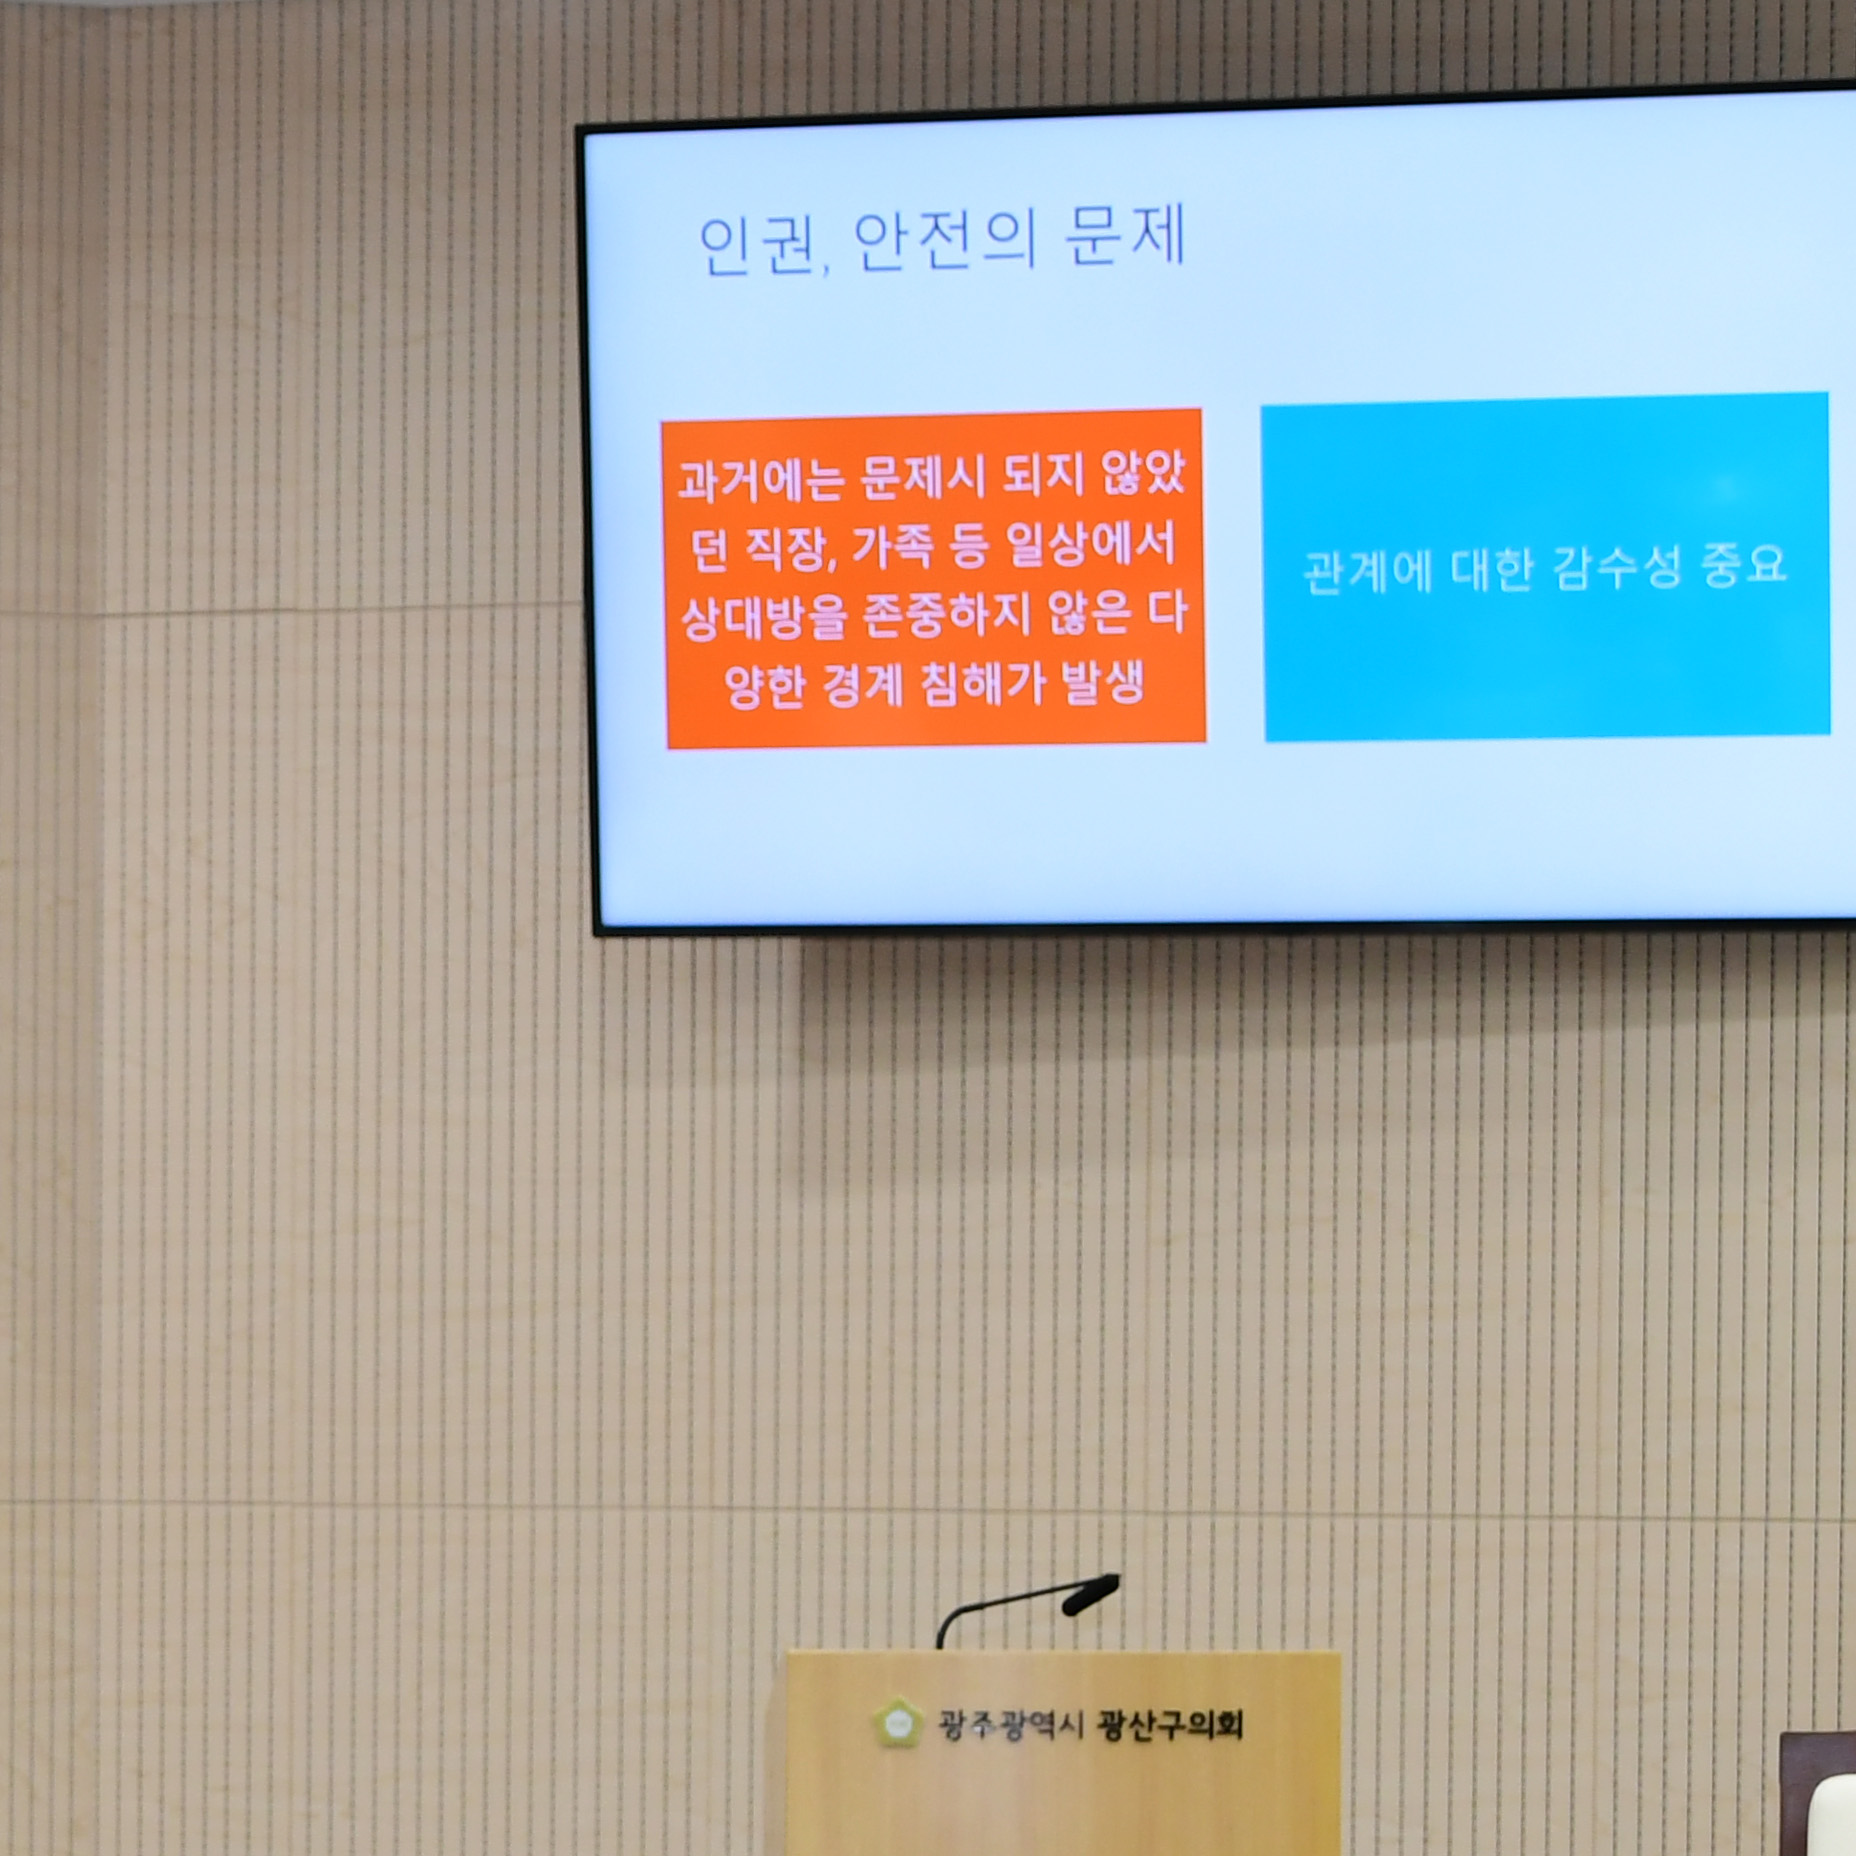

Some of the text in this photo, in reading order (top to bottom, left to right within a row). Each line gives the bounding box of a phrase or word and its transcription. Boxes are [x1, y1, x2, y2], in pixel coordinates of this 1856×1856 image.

[701, 203, 1183, 276] 인권, 안전의 문제
[679, 449, 1186, 504] 과거에는 문제시 되지 않았
[692, 519, 1174, 573] 던 직장, 가족 등 일상에서
[1304, 542, 1788, 595] 관계에 대한 감수성 중요
[682, 589, 1189, 642] 상대방을 존중하지 않은 다
[725, 659, 1144, 710] 양한 경계 침해가 발생
[939, 1709, 1243, 1743] 광주광역시 광산구의회
